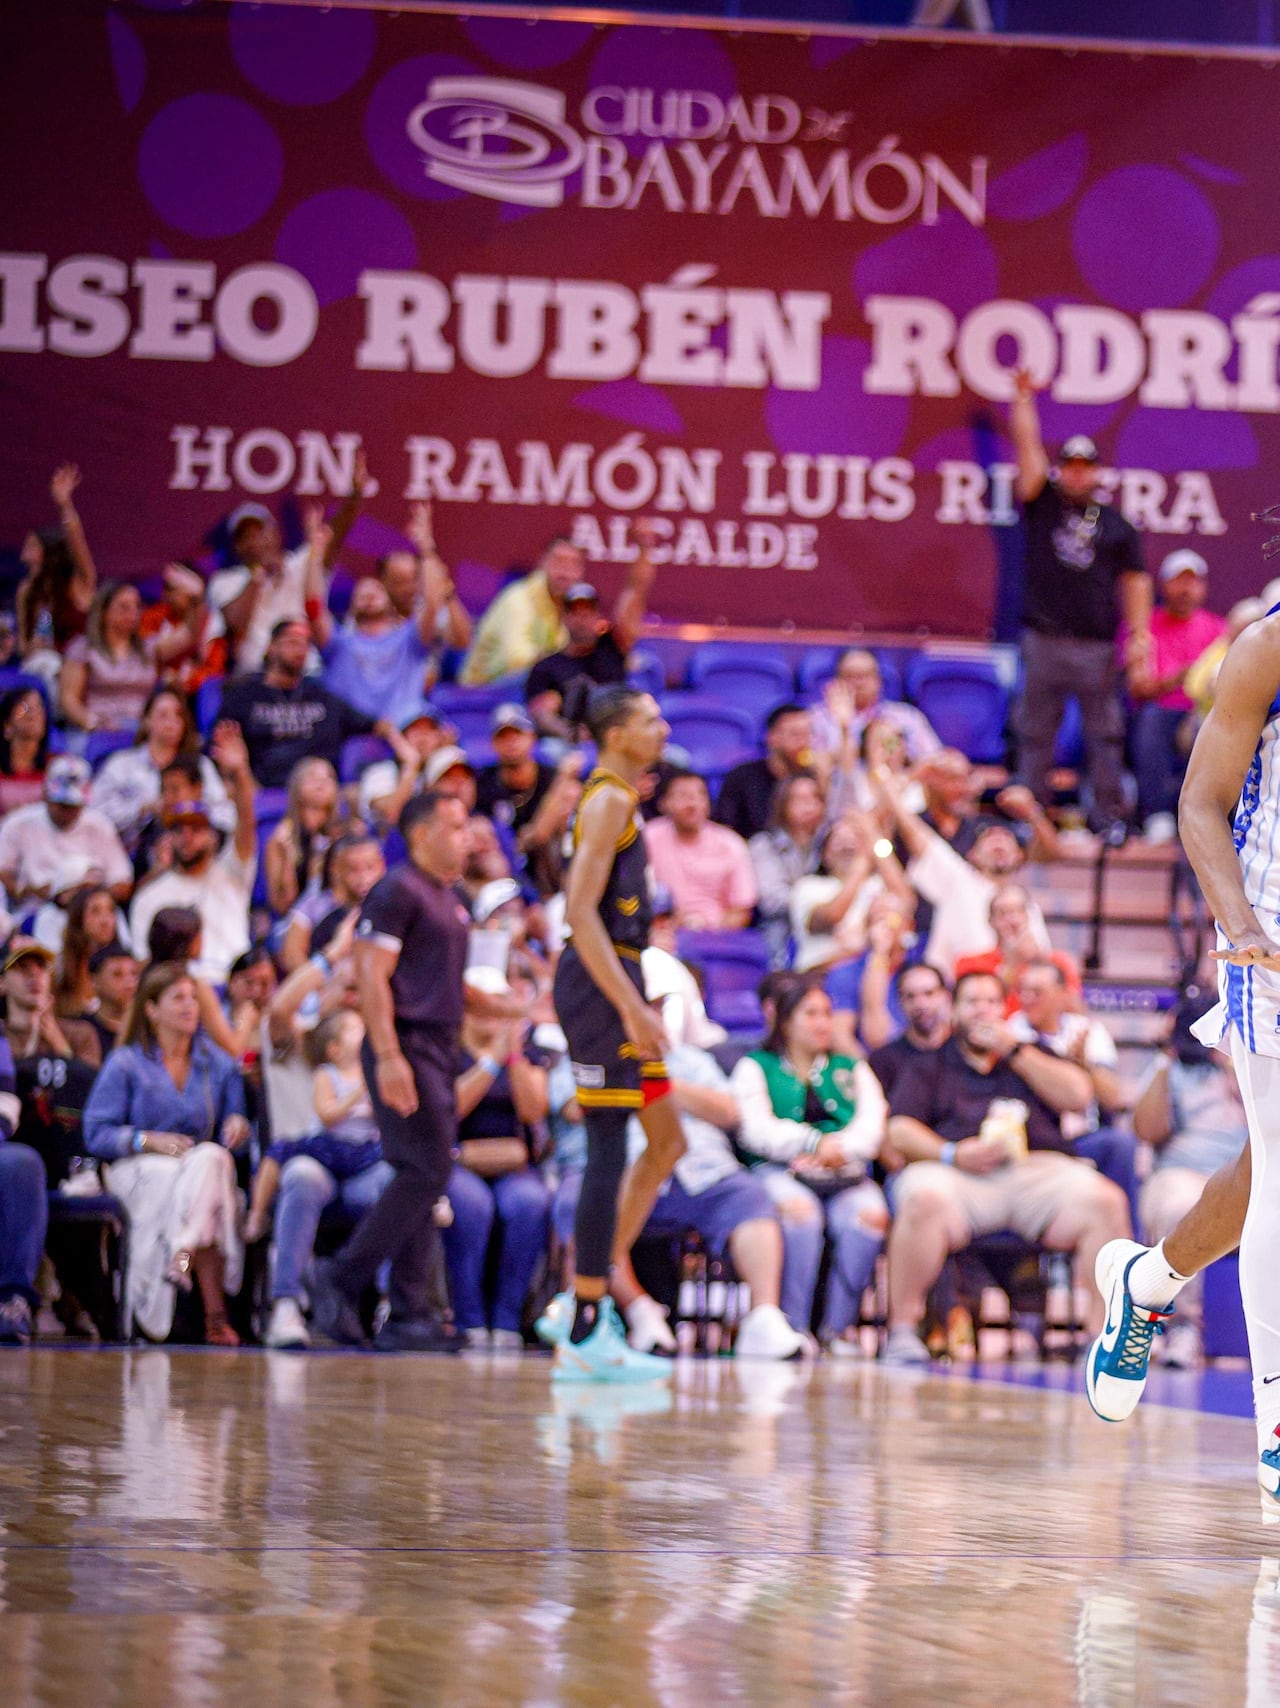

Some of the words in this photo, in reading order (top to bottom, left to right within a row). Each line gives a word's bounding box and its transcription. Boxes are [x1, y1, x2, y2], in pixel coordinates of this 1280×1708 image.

[581, 85, 801, 145] CIUDAD
[580, 136, 989, 227] BAYAMÓN
[356, 262, 832, 391] RUBÉN
[168, 425, 380, 499] HON.
[405, 432, 722, 512] RAMÓN
[743, 452, 917, 518] LUIS
[934, 459, 1228, 536] RIRA
[570, 517, 818, 571] ALCALDE
